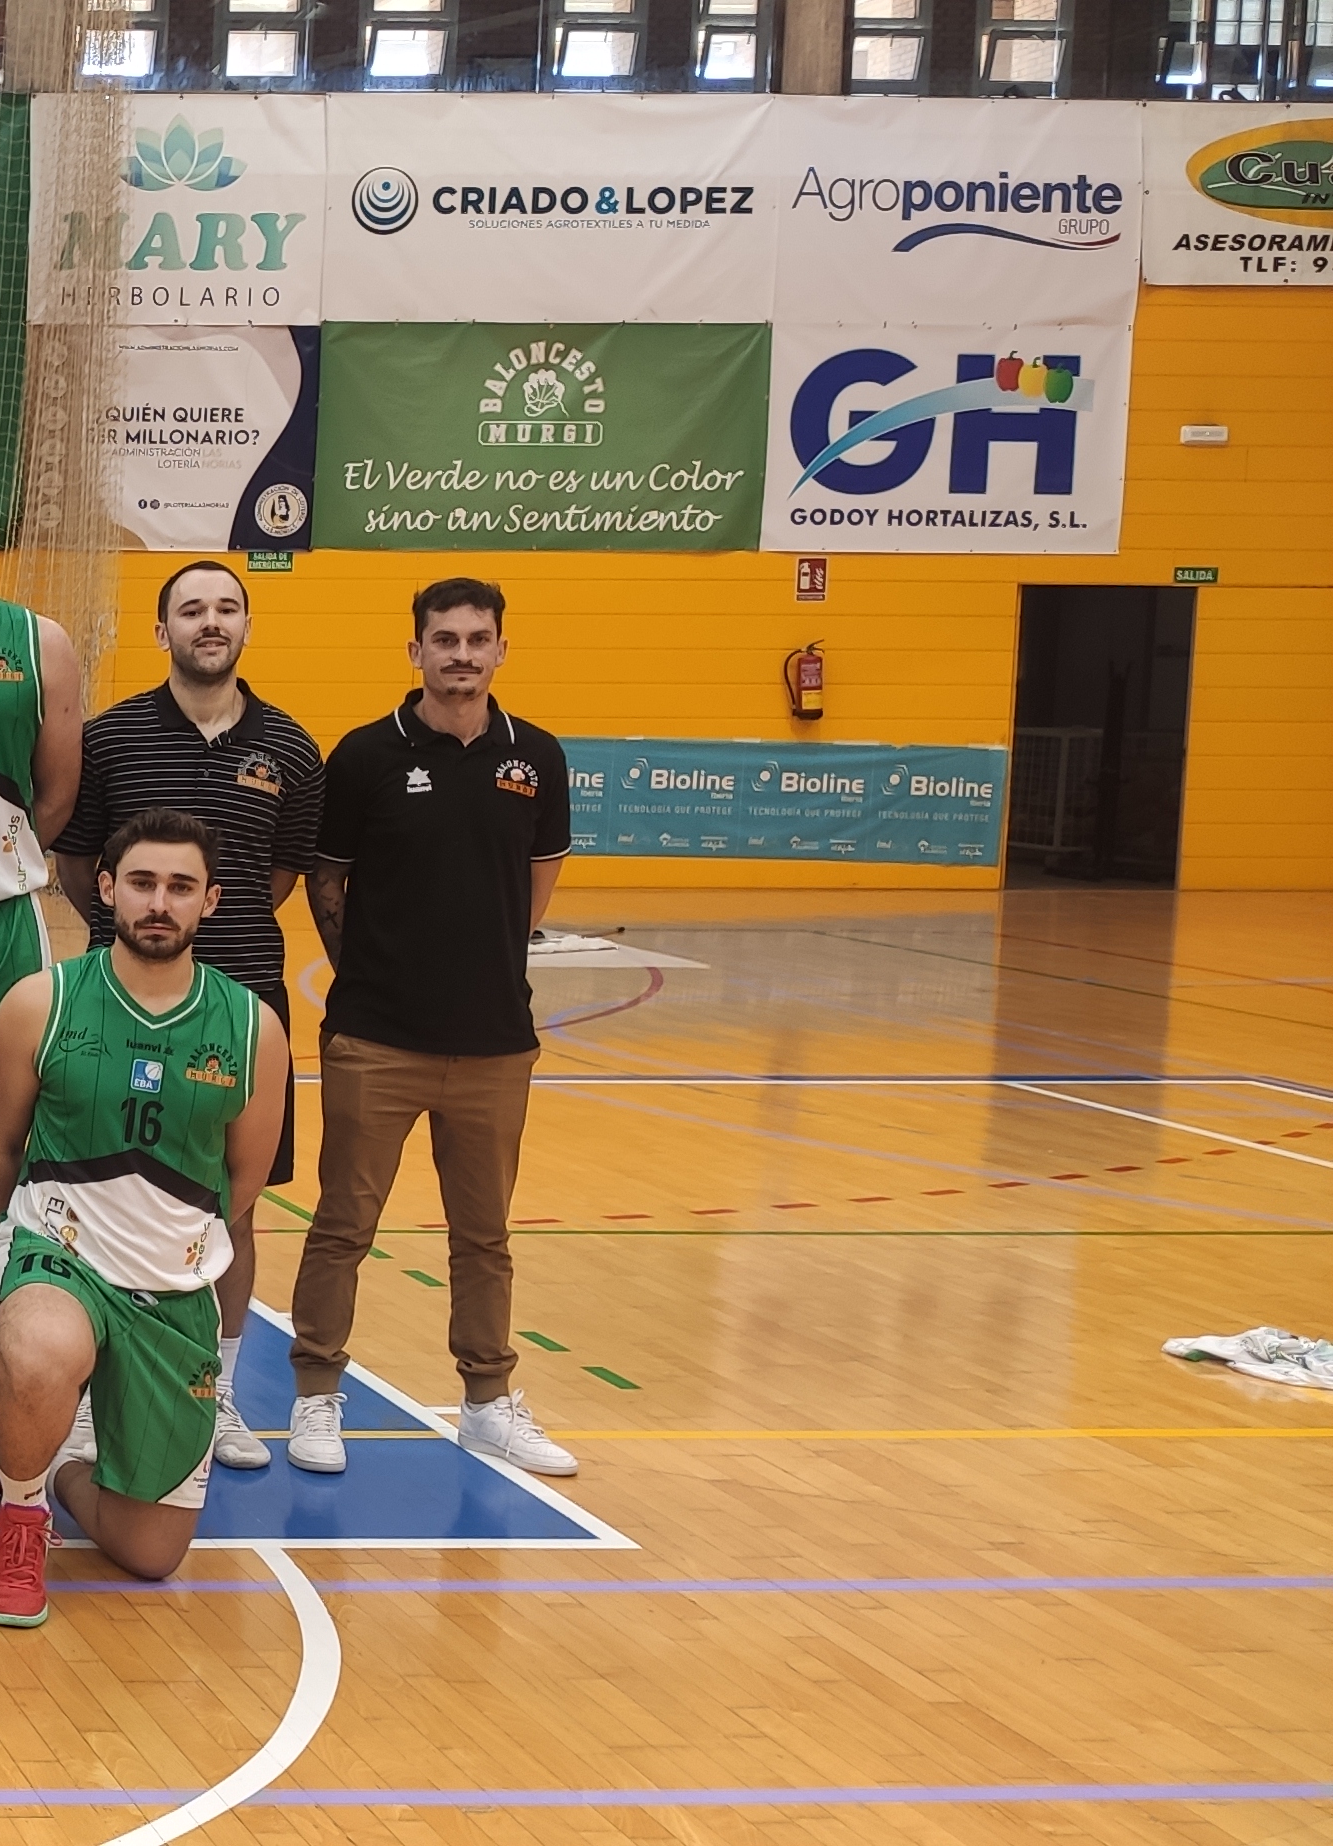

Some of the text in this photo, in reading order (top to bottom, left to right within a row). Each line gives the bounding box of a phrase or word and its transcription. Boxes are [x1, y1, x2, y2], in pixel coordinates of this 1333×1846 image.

[792, 166, 1123, 222] Agroponiente
[469, 219, 711, 229] SOLUCIONES AGROTEXTILES A TU MEDIDA
[1058, 219, 1110, 236] GRUPO
[1240, 257, 1296, 273] TLF:
[480, 341, 606, 414] BALONCESTO
[173, 407, 244, 423] QUIERE
[790, 348, 1081, 495] GH
[126, 430, 260, 446] MILLONARIO?
[488, 424, 594, 444] MURGI
[158, 458, 200, 468] LOTERÍA
[344, 459, 744, 493] El Verde no es un Color
[364, 503, 722, 533] sino un Sentimiento
[790, 508, 1088, 531] GODOY HORTALIZAS, S.L.
[1176, 569, 1215, 582] SALIDA
[496, 759, 539, 788] BALONCESTO
[651, 769, 735, 790] Bioline
[781, 772, 864, 794] Bioline
[910, 776, 993, 798] Bioline
[134, 1079, 154, 1090] EBA
[120, 1097, 165, 1147] 16
[21, 1252, 73, 1280] 16
